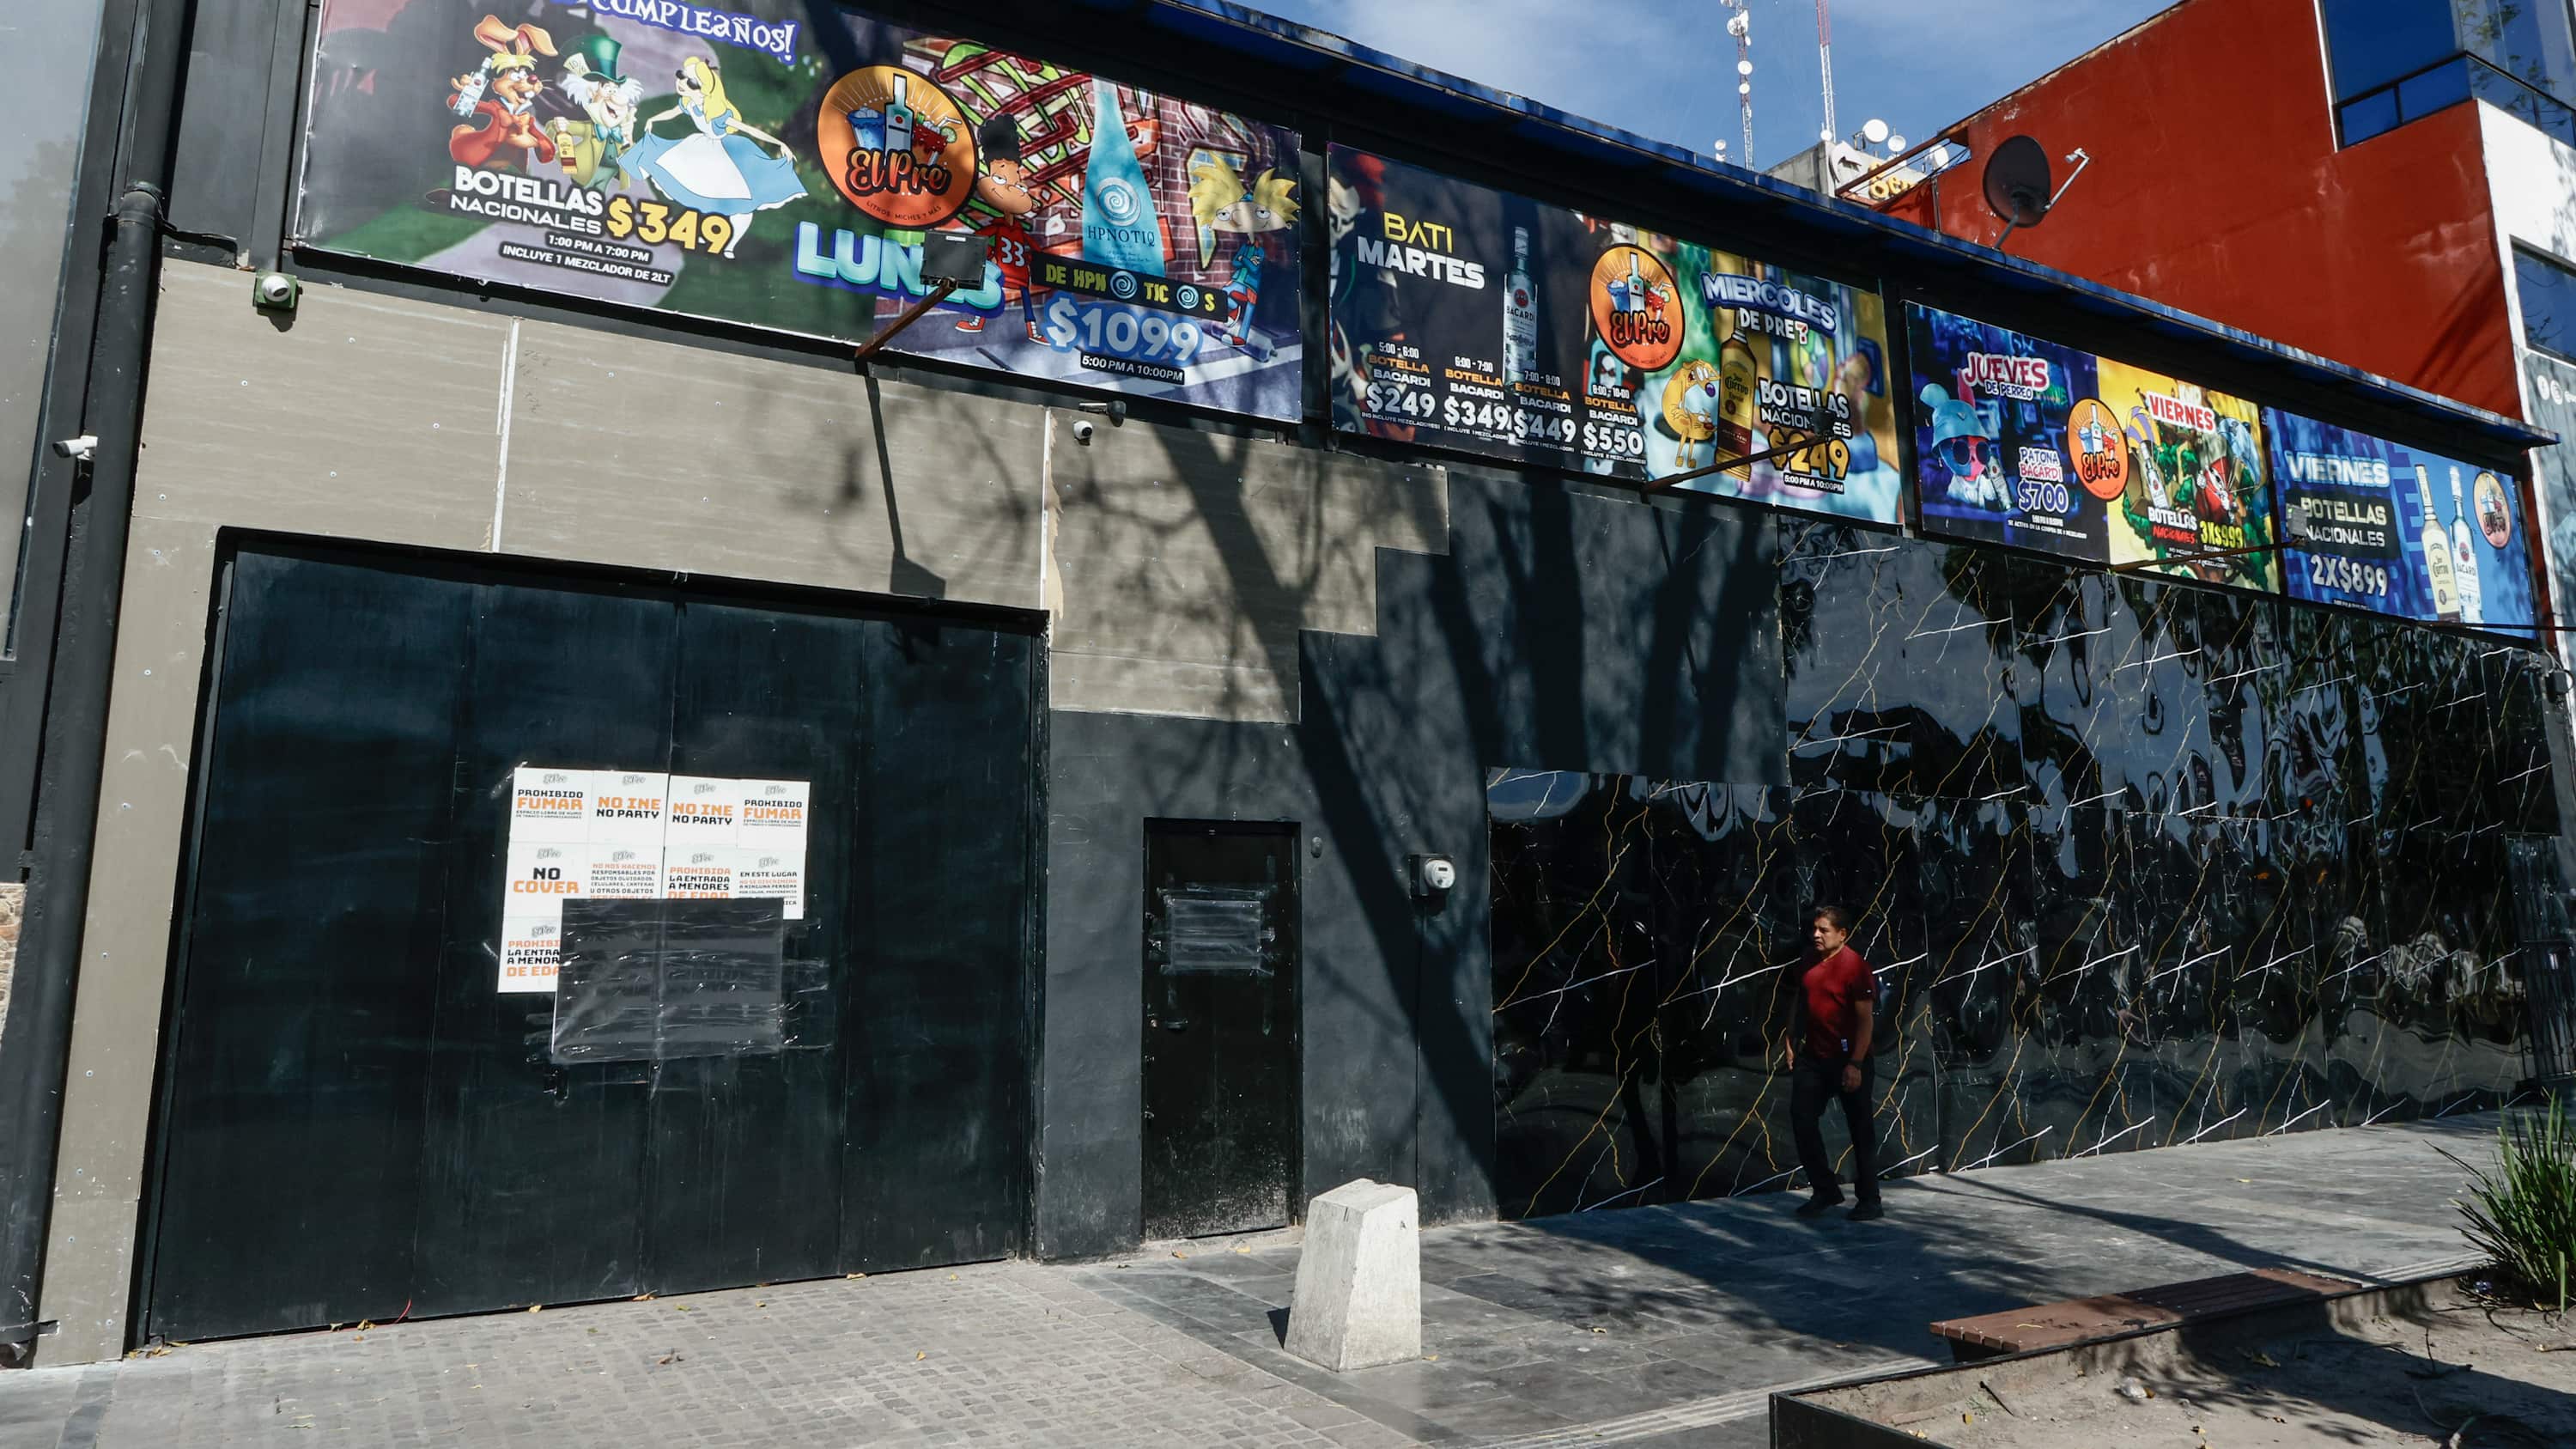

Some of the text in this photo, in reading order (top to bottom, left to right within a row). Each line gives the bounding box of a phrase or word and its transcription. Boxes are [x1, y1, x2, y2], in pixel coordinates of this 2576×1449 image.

[849, 149, 948, 191] El Pre
[455, 165, 604, 216] BOTELLAS
[450, 194, 602, 235] NACIONALES
[606, 197, 732, 255] $349
[1088, 225, 1155, 247] HPNOTIQ
[1383, 211, 1453, 253] BATI
[548, 234, 649, 262] 1:00 PM A 7:00 PM
[1000, 236, 1024, 267] 33
[502, 245, 671, 284] INCLUYE 1 MEZCLADOR DE 2LT
[797, 221, 1002, 310] LUNS
[1046, 263, 1066, 285] DE
[1358, 236, 1485, 289] MARTES
[1702, 274, 1836, 331] MIERCOLES
[1047, 297, 1199, 362] $1099
[1611, 312, 1668, 344] El Pre
[1739, 307, 1760, 331] DE
[1379, 342, 1419, 359] 5:00 6:00
[1082, 355, 1183, 381] 5:00 PM A 10:00PM
[1369, 355, 1430, 374] BOTELLA
[1477, 360, 1493, 373] 7:00
[1524, 370, 1540, 382] 7:00
[1964, 355, 2048, 388] JUEVES
[1373, 369, 1431, 387] BACARDI
[1445, 368, 1503, 387] BOTELLA
[1366, 382, 1436, 418] $249
[1449, 382, 1504, 401] BACARDI
[1515, 382, 1571, 400] BOTELLA
[1759, 379, 1850, 419] BOTELLAS
[1985, 381, 2032, 399] DE PERREO
[1443, 395, 1509, 430] $349
[1520, 396, 1571, 413] BACARDI
[1584, 396, 1637, 413] BOTELLA
[2149, 393, 2215, 431] VIERNES
[1514, 409, 1577, 443] $449
[1589, 410, 1637, 427] BACARDI
[1761, 408, 1851, 438] NACIONES
[1583, 422, 1644, 455] $550
[1769, 429, 1850, 478] $249
[2020, 448, 2059, 464] PATONA
[2020, 464, 2063, 481] BACARDI
[2081, 453, 2119, 480] El Pre
[2285, 451, 2390, 488] VIERNES
[1784, 475, 1799, 484] 5:00
[1799, 477, 1809, 486] PM
[2019, 480, 2068, 513] $700
[2148, 506, 2197, 531] BOTELLAS
[2300, 496, 2387, 527] BOTELLAS
[2306, 524, 2385, 547] NACIONALES
[2310, 554, 2388, 598] 2X$899
[517, 797, 583, 810] FUMAR
[518, 788, 584, 798] PROHIBIDO
[598, 796, 661, 810] NO INE
[617, 809, 659, 819] PARTY
[673, 802, 733, 816] NO INE
[692, 816, 732, 825] PARTY
[744, 807, 802, 819] FUMAR
[533, 867, 561, 880] NO
[513, 880, 579, 893] COVER
[507, 966, 559, 977] DE EDA
